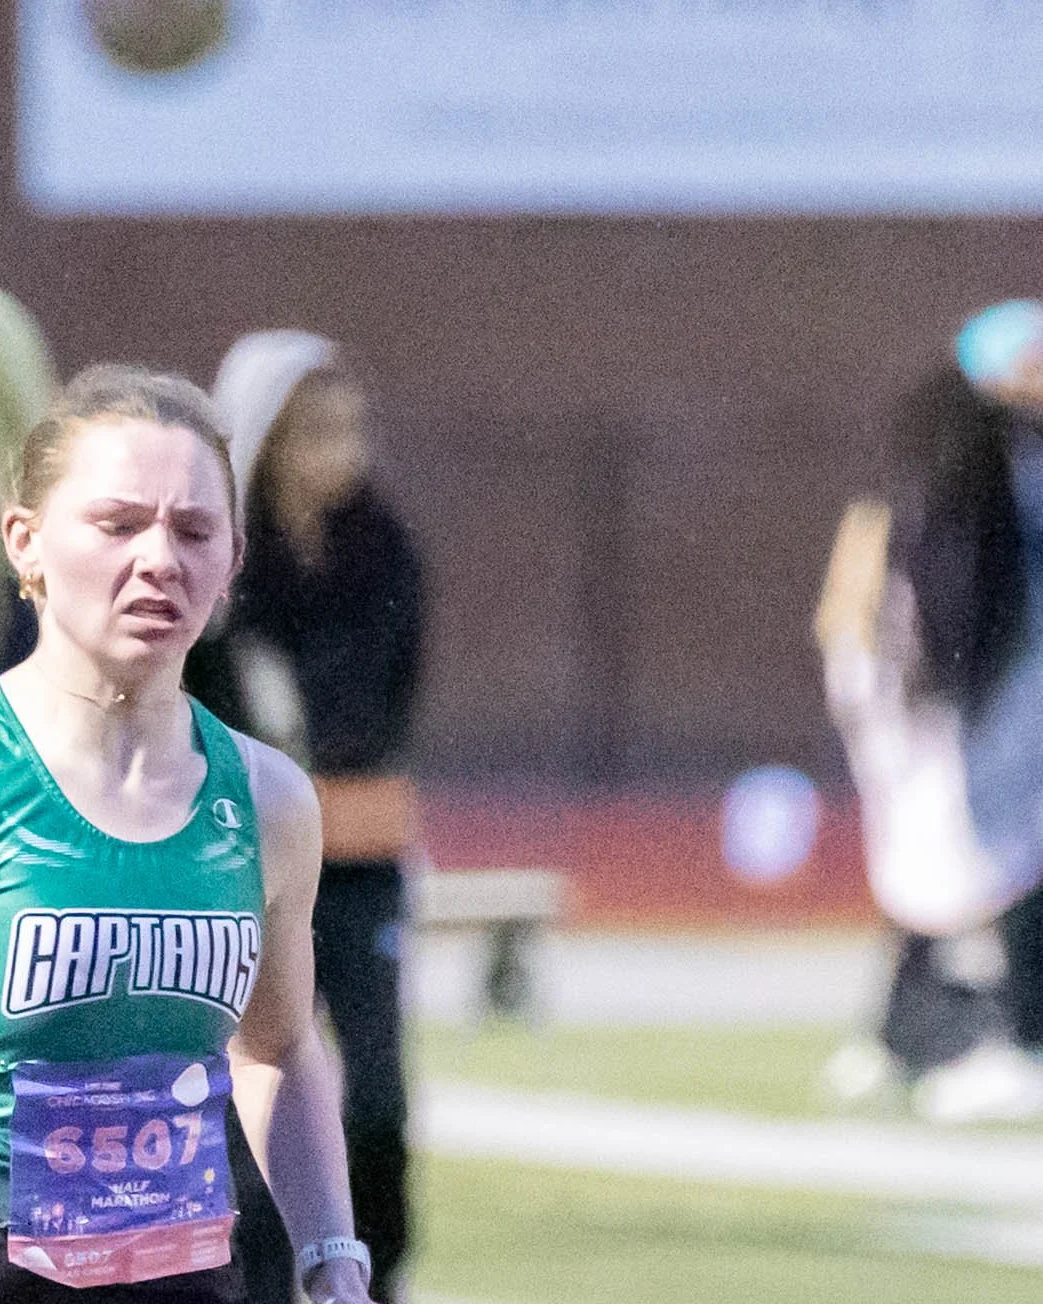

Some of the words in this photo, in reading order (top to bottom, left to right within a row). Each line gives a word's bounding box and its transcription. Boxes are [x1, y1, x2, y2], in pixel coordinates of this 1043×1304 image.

[2, 909, 260, 1021] CAPTAINS
[44, 1111, 202, 1174] 6507
[91, 1192, 170, 1209] MARATHON
